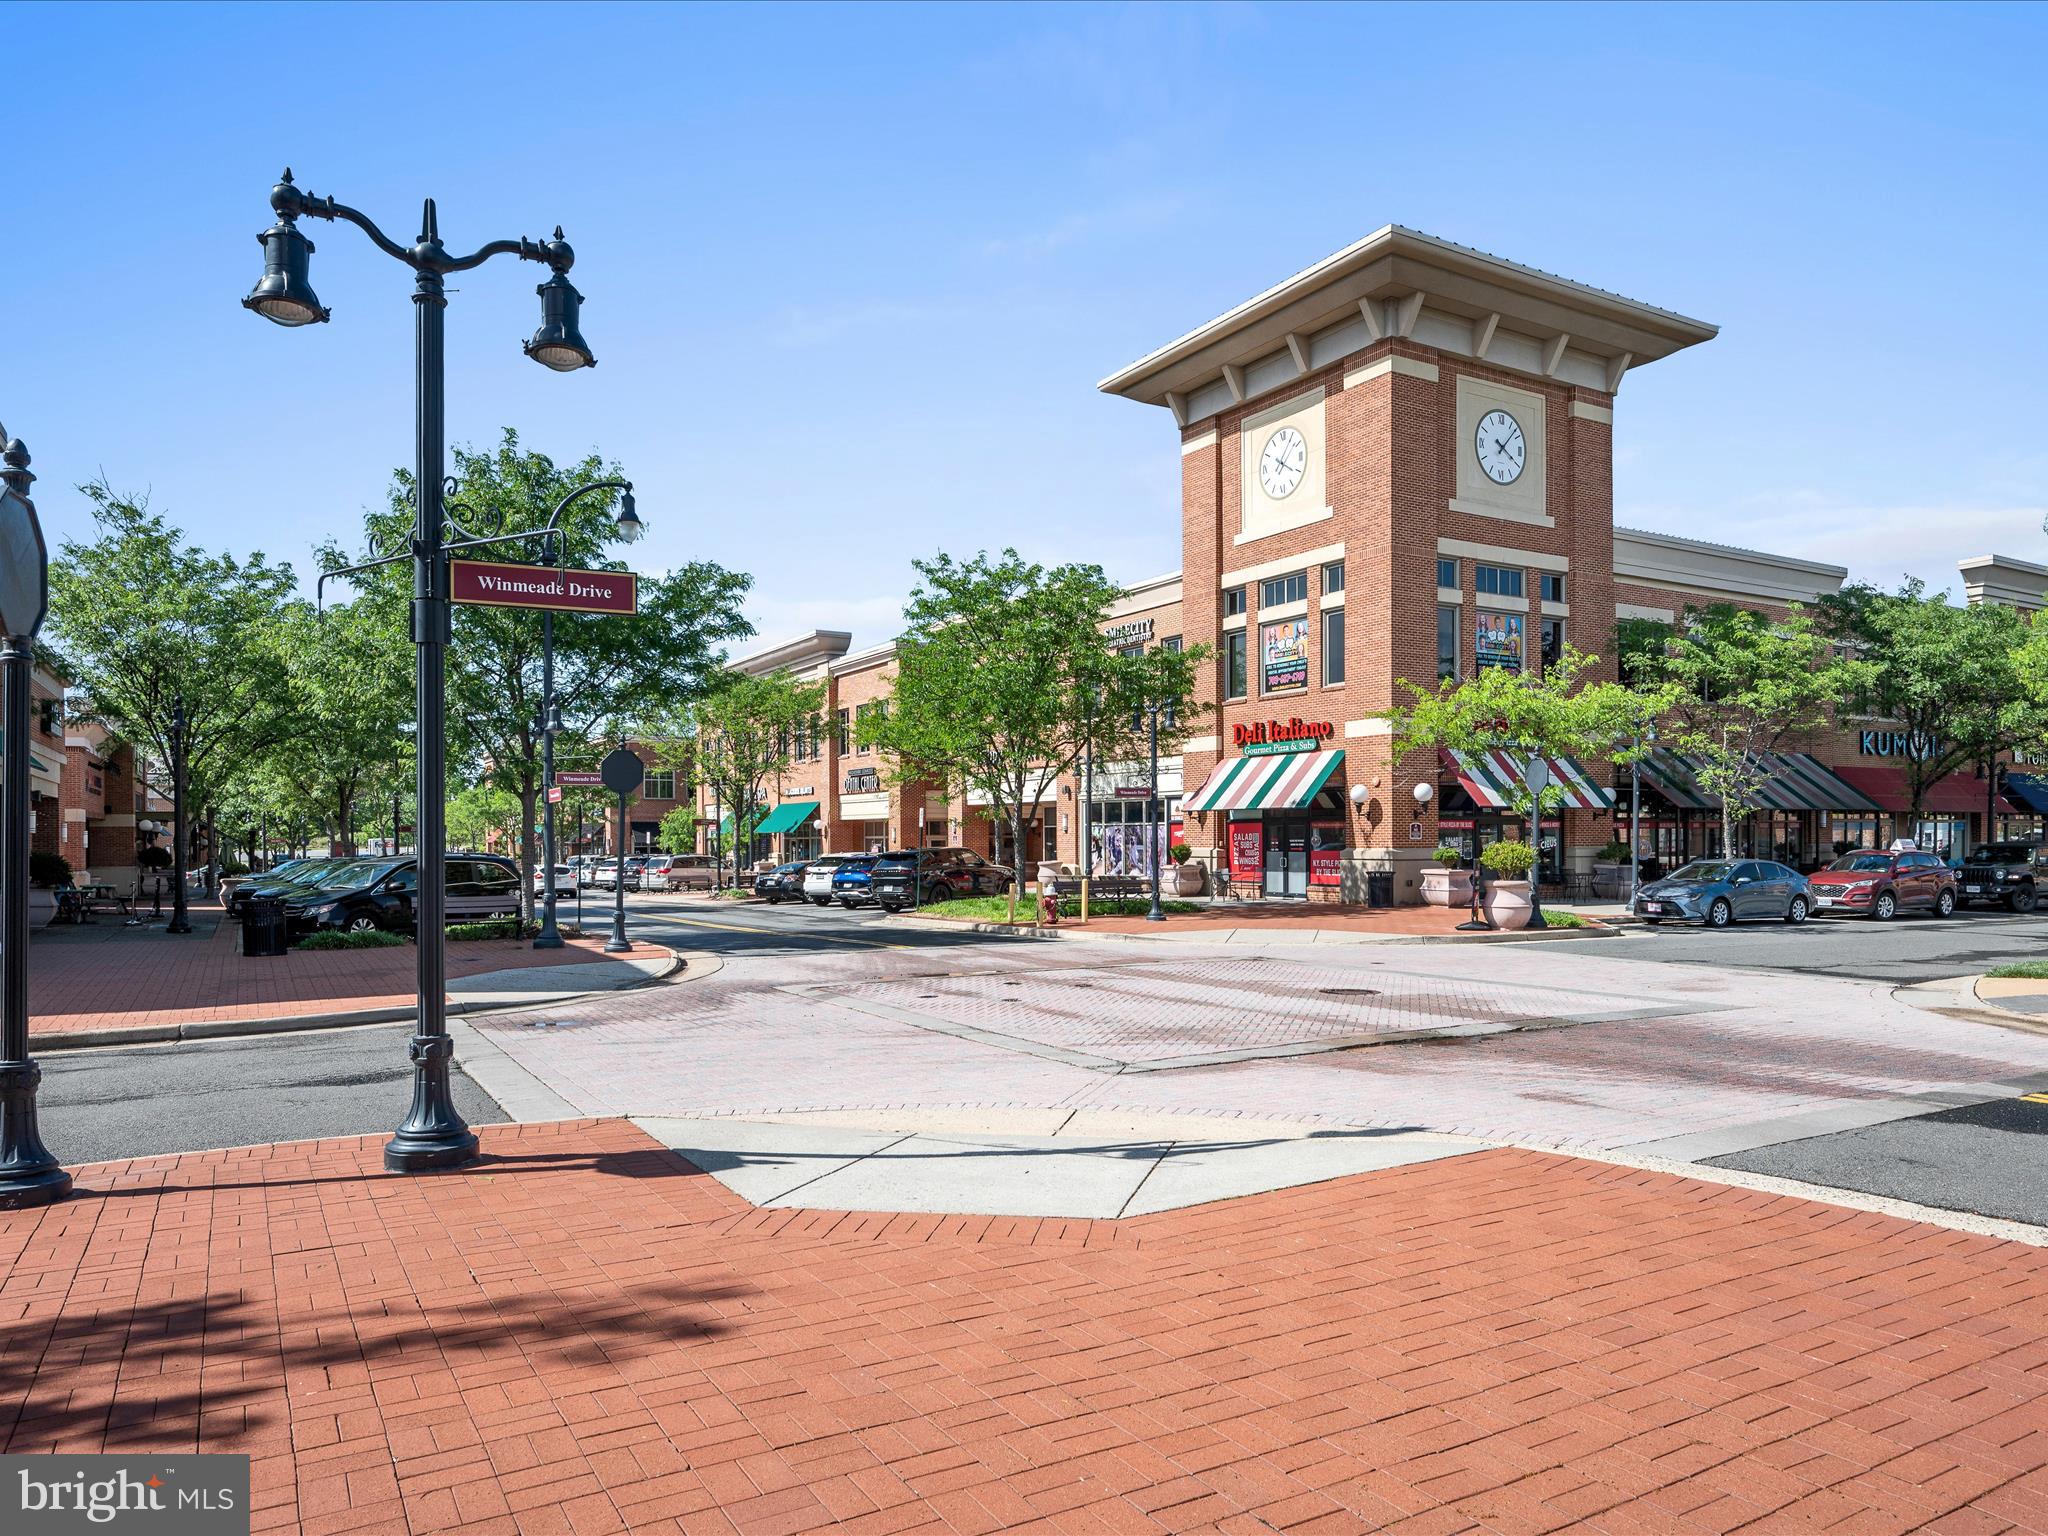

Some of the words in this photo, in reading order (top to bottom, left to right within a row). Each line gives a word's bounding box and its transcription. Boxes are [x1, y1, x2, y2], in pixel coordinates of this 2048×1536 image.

[477, 575, 565, 595] Winmeade
[569, 583, 612, 599] Drive
[1232, 722, 1263, 744] Deli
[1267, 717, 1331, 741] Italiano
[1244, 745, 1272, 755] Gourmet
[1273, 743, 1289, 752] Pizza
[1290, 742, 1297, 750] &
[1299, 741, 1315, 750] Subs
[1862, 729, 1937, 762] KUMO
[1239, 857, 1255, 865] WINGS
[1320, 859, 1334, 867] STYLE
[1323, 868, 1331, 876] THE
